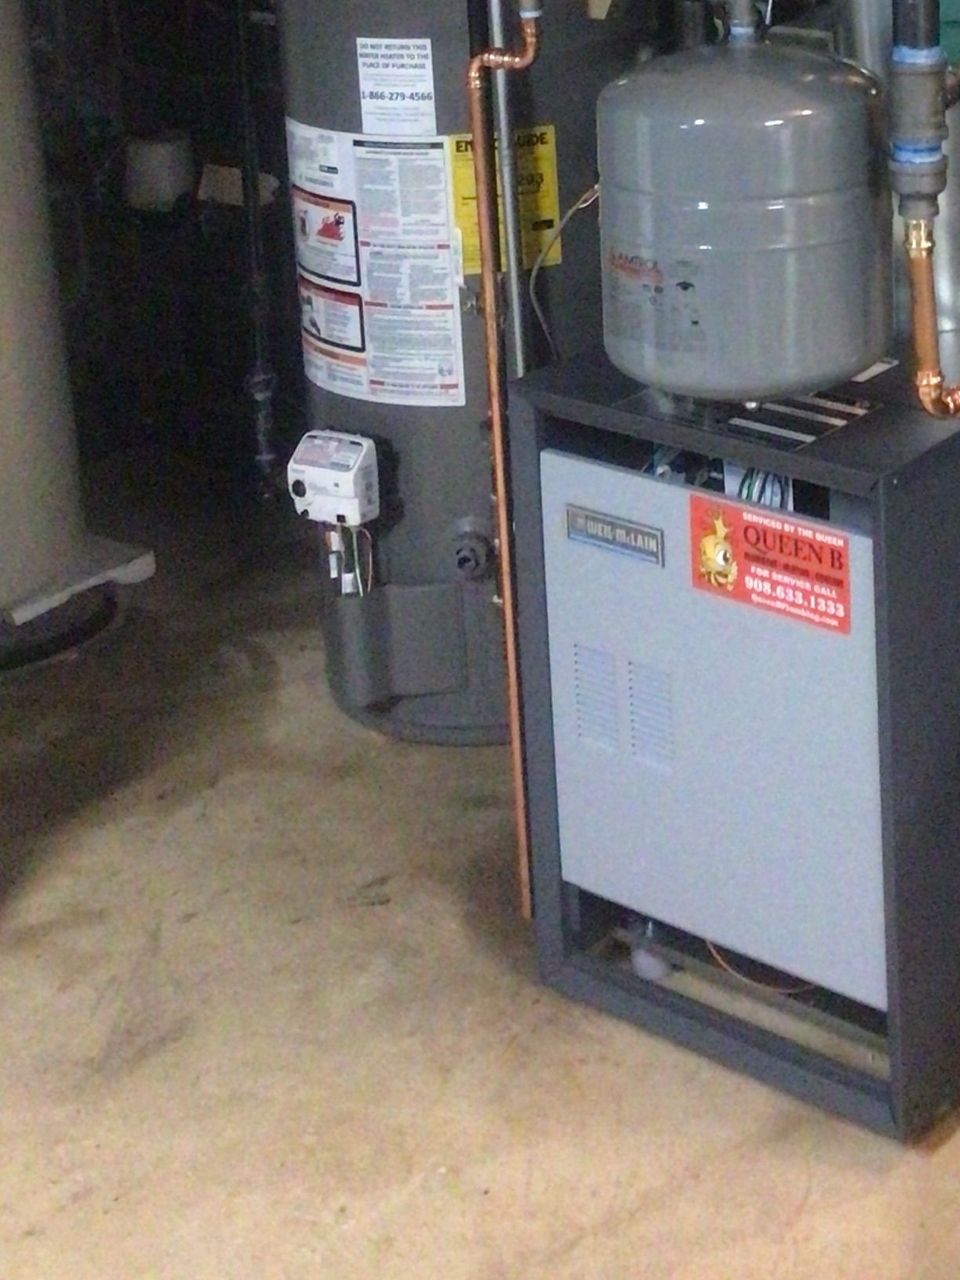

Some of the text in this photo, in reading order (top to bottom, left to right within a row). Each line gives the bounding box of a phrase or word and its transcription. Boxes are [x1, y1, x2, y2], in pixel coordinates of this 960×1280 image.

[384, 43, 411, 51] RETURN
[380, 52, 405, 60] HEATER
[417, 52, 429, 60] THE
[362, 61, 380, 69] PLACE
[391, 62, 427, 70] PURCHASE
[361, 90, 433, 101] 1-866-279-4566
[742, 511, 844, 547] SERVICED BY THE QUEEN
[743, 524, 823, 565] QUEEN
[829, 547, 844, 571] B
[750, 565, 770, 578] FOR
[771, 571, 812, 592] SERVICE
[813, 584, 838, 599] CALL
